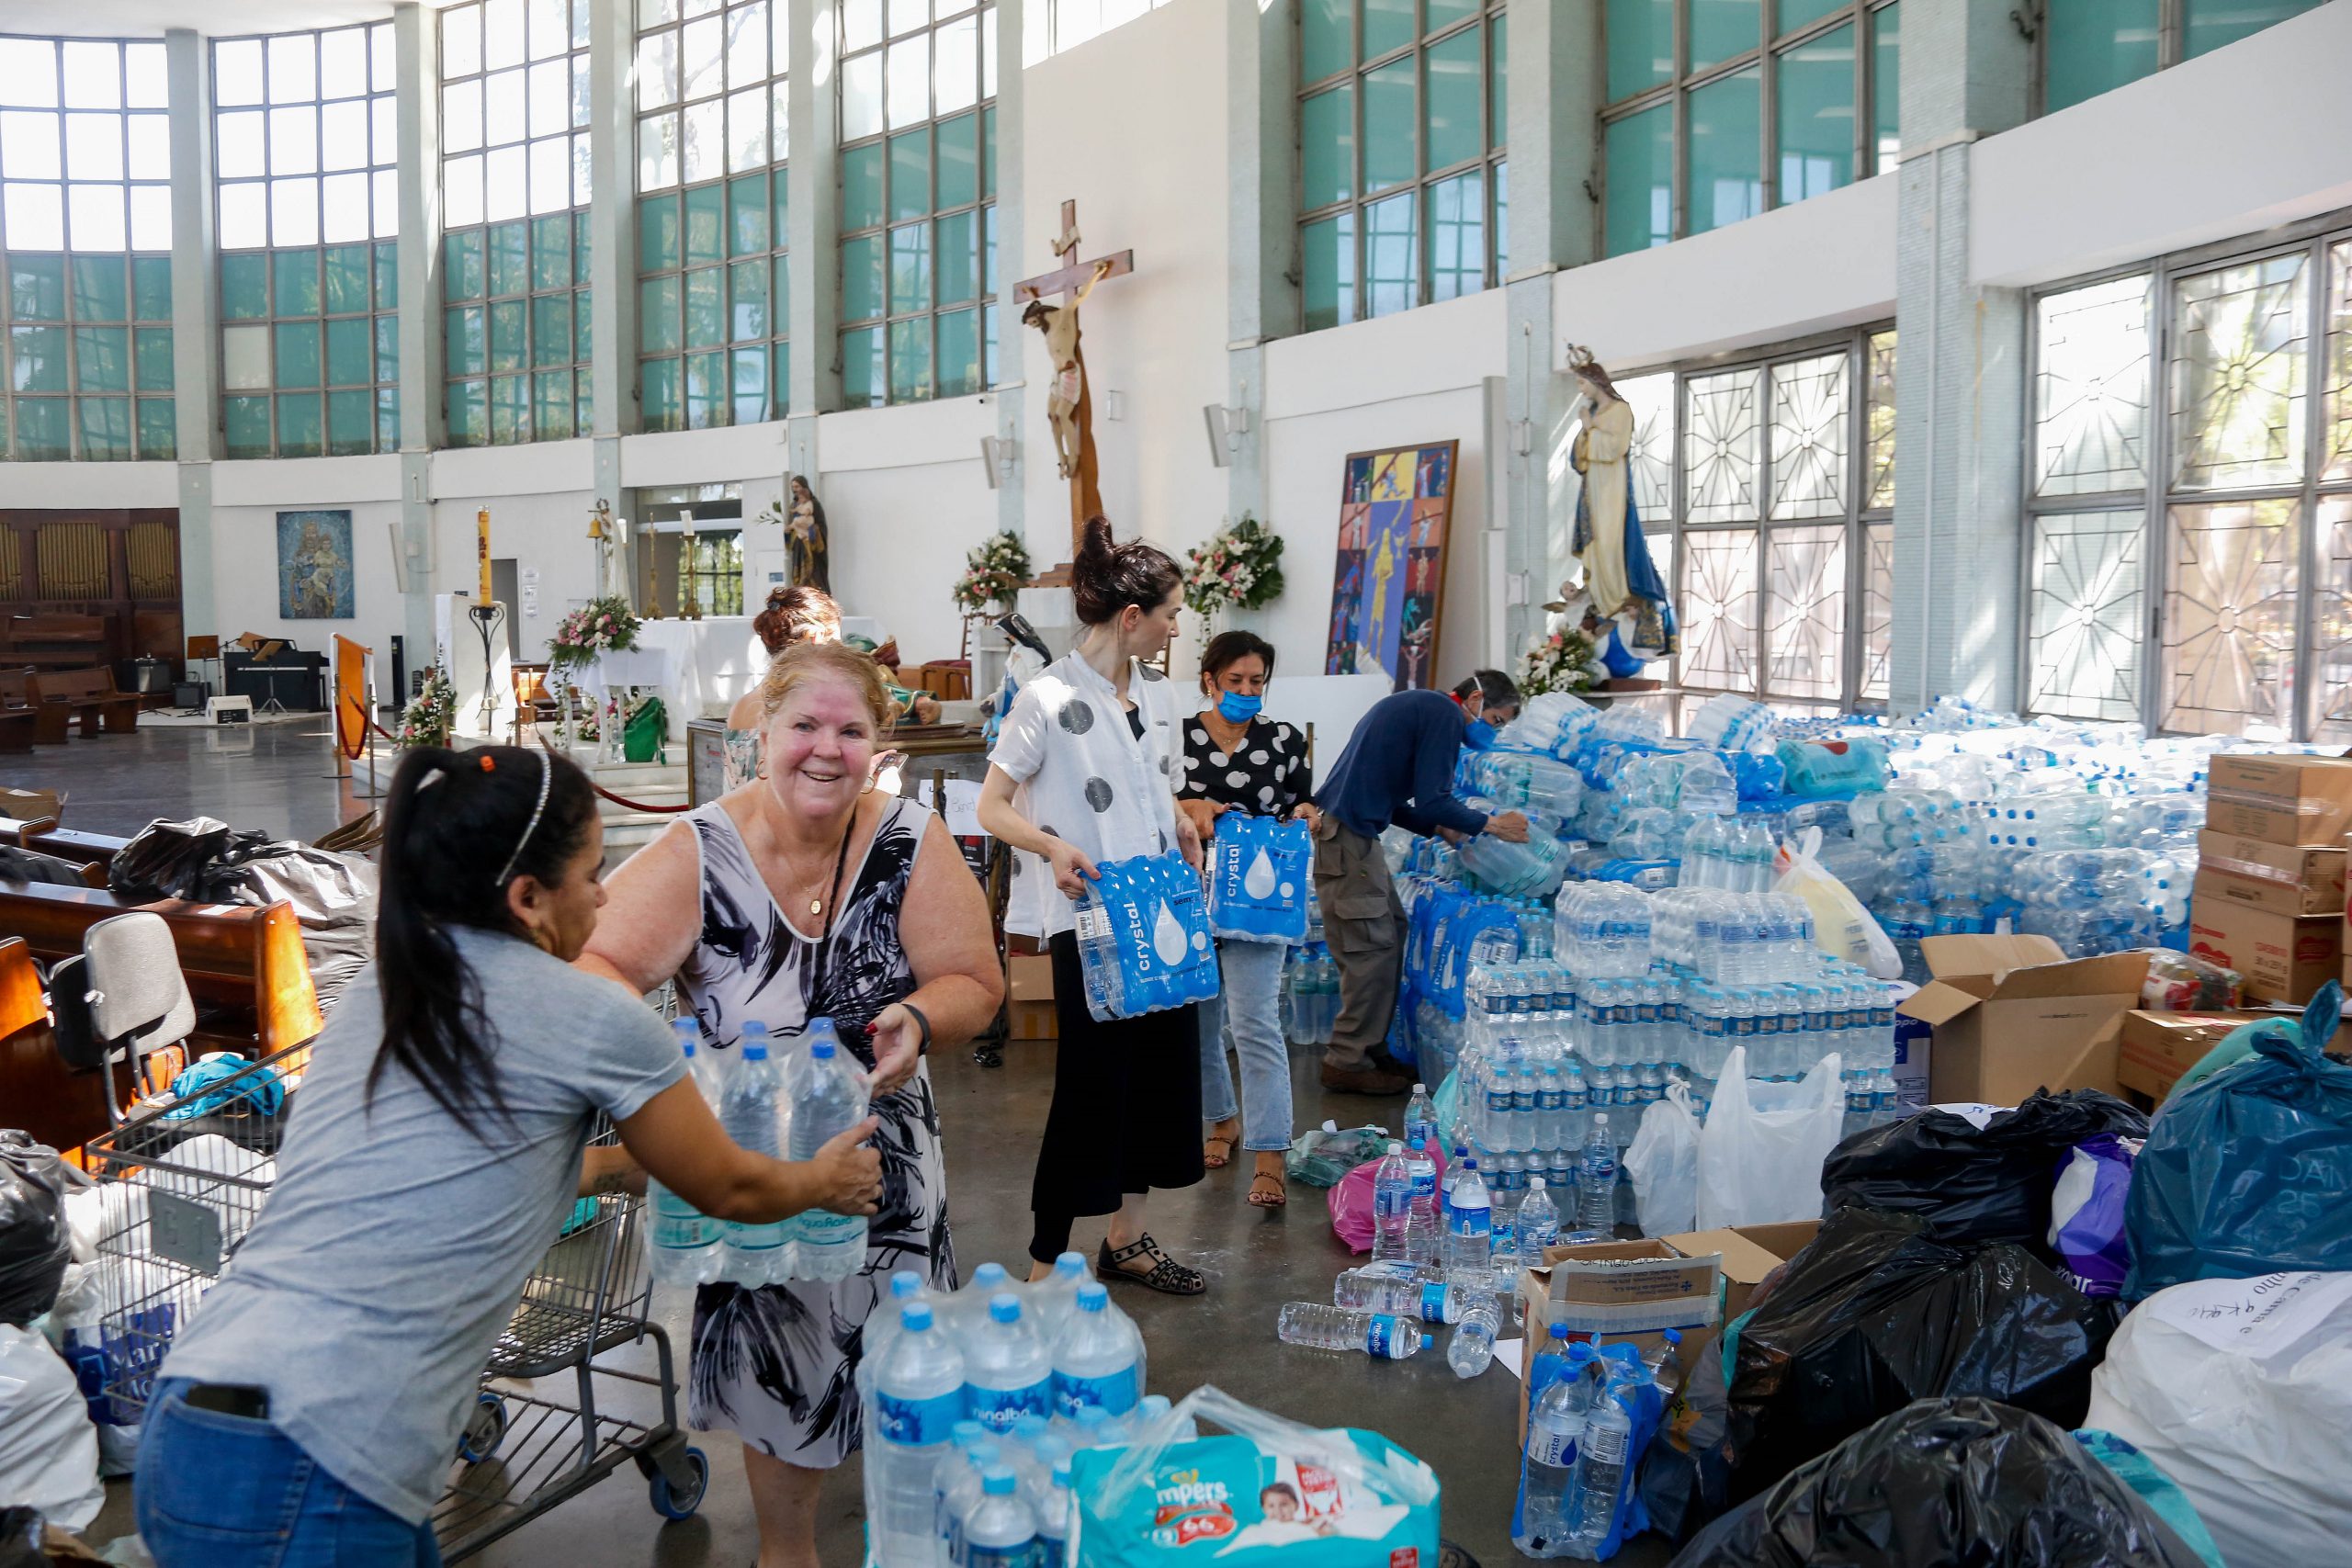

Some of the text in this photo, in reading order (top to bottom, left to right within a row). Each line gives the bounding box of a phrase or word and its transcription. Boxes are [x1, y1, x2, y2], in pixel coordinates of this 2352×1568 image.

[1227, 843, 1241, 897] crystal
[1124, 902, 1151, 971] crystal
[2254, 1271, 2288, 1295] nho
[1548, 1434, 1560, 1465] crystal
[1619, 1439, 1629, 1463] crystal
[1157, 1481, 1228, 1506] mpers
[1182, 1517, 1215, 1533] 66
